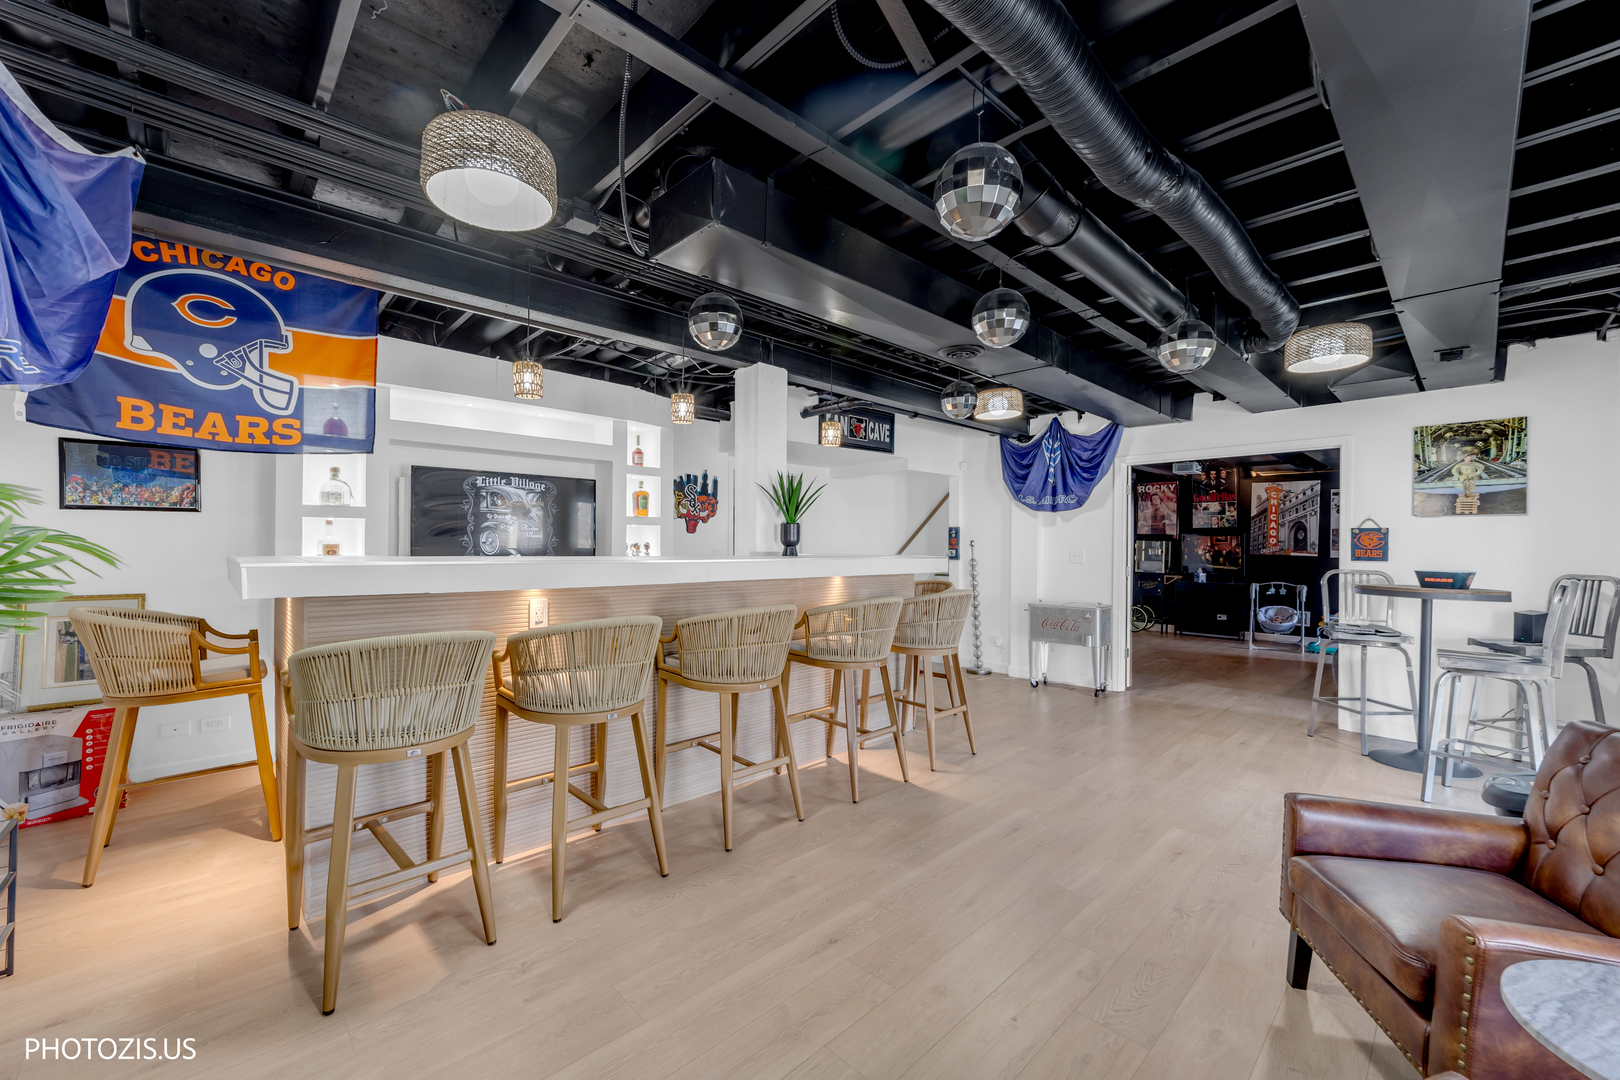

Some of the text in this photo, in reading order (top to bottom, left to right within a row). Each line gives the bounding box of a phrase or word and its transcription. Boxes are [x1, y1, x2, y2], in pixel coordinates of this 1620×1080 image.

[132, 240, 296, 291] CHICAGO
[115, 395, 303, 446] BEARS
[868, 421, 890, 442] CAVE
[475, 476, 546, 491] Little Village
[1138, 484, 1176, 493] ROCKY
[1269, 491, 1278, 544] CHICAGO
[1355, 549, 1383, 558] BEARS
[1, 720, 57, 731] FRIGIDAIRE
[2, 725, 56, 736] GALLERY
